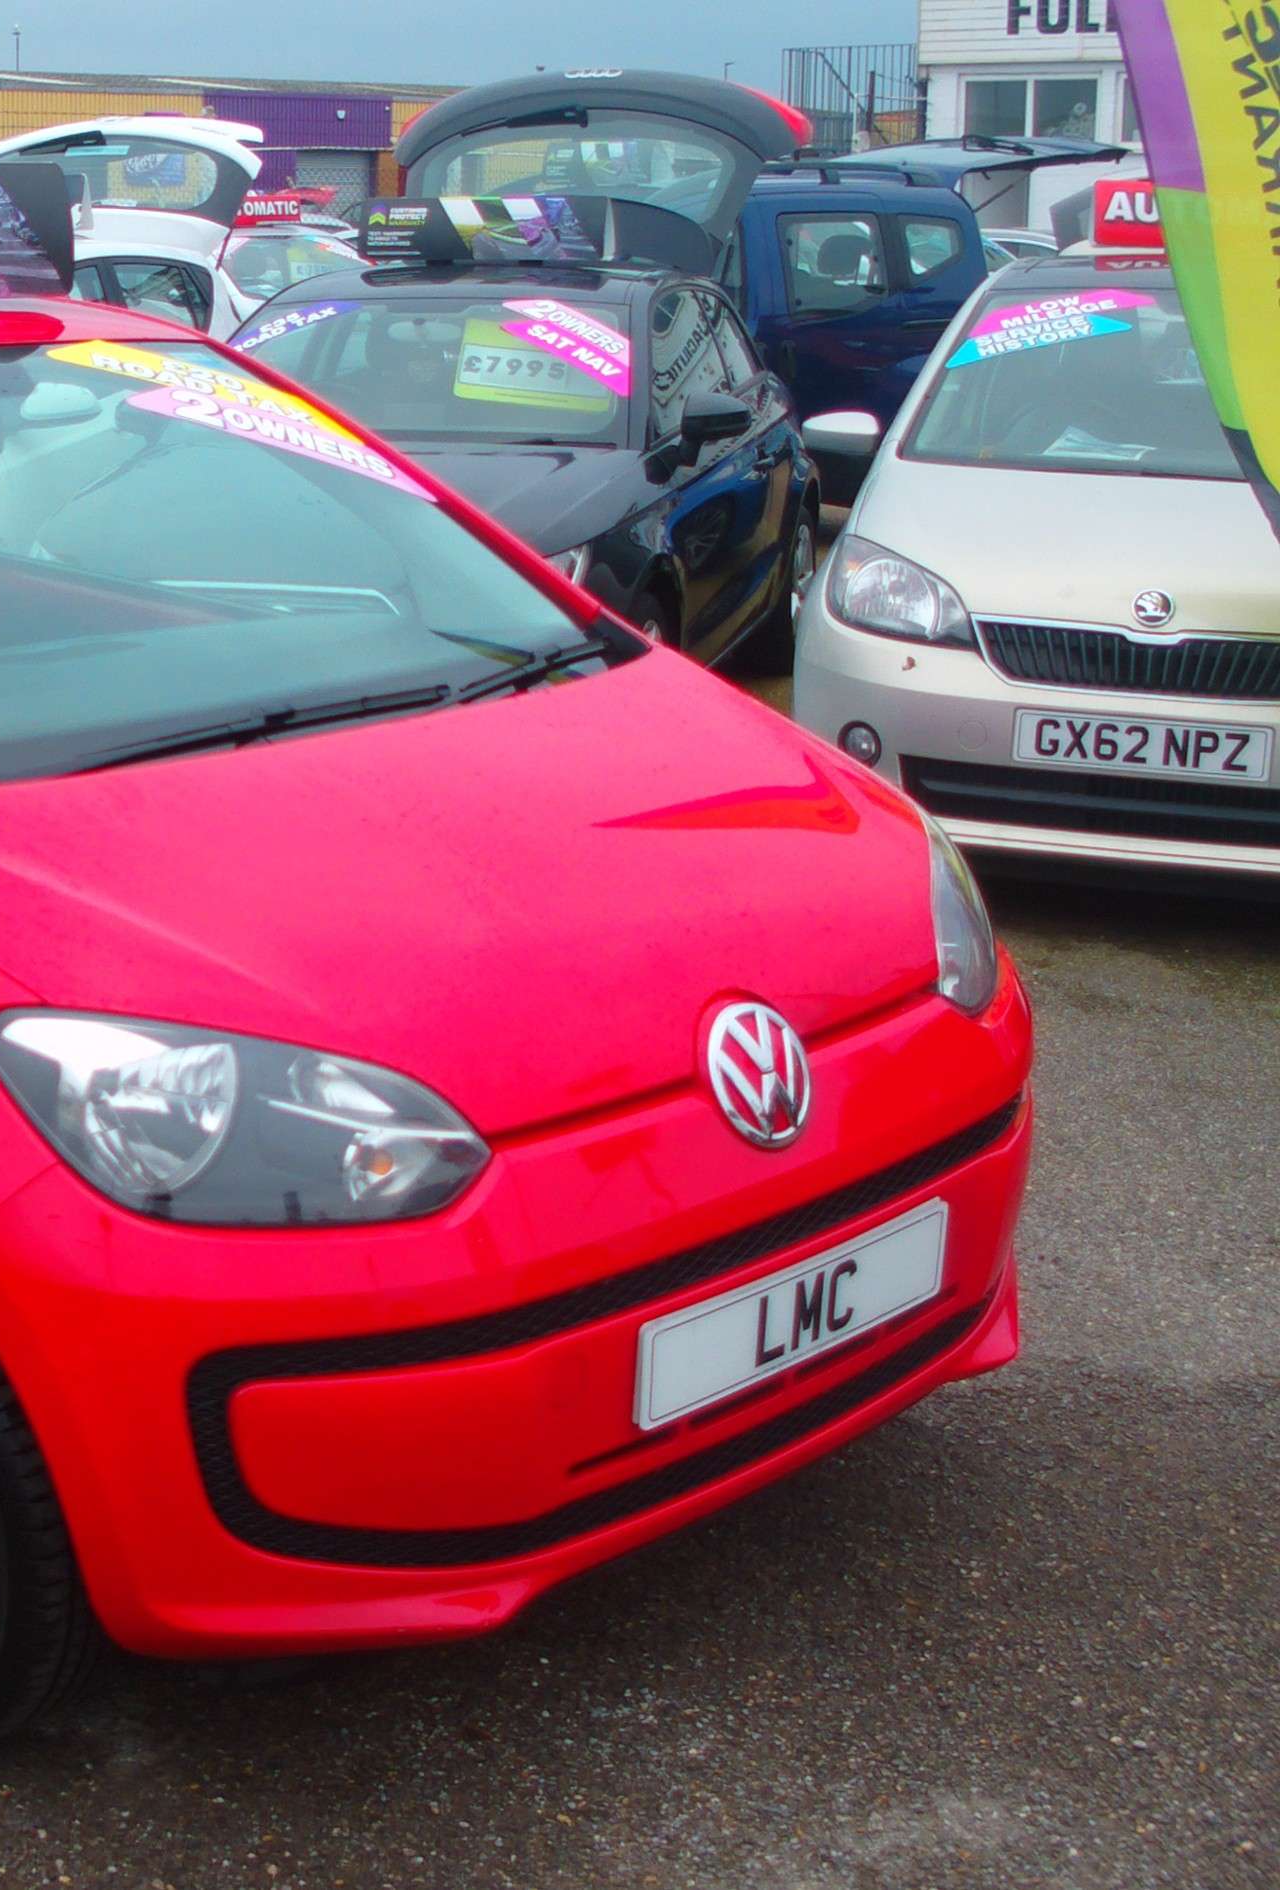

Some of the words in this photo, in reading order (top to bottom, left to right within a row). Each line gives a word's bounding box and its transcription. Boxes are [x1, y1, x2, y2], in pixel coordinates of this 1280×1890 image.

[236, 200, 299, 216] OMATIC
[290, 306, 338, 327] TAX
[1000, 299, 1118, 329] MILEAGE
[1025, 295, 1081, 315] LOW
[552, 309, 624, 356] OWNERS
[974, 314, 1090, 346] SERVICE
[977, 324, 1092, 357] HISTORY
[527, 324, 577, 350] SAT
[571, 346, 623, 377] NAV
[463, 355, 567, 381] £7995
[90, 352, 217, 395] ROAD
[233, 392, 322, 427] TAX
[170, 388, 226, 430] 2
[223, 407, 396, 480] OWNERS
[1034, 717, 1149, 766] GX62
[1162, 728, 1251, 773] NPZ
[754, 1258, 858, 1368] LMC
